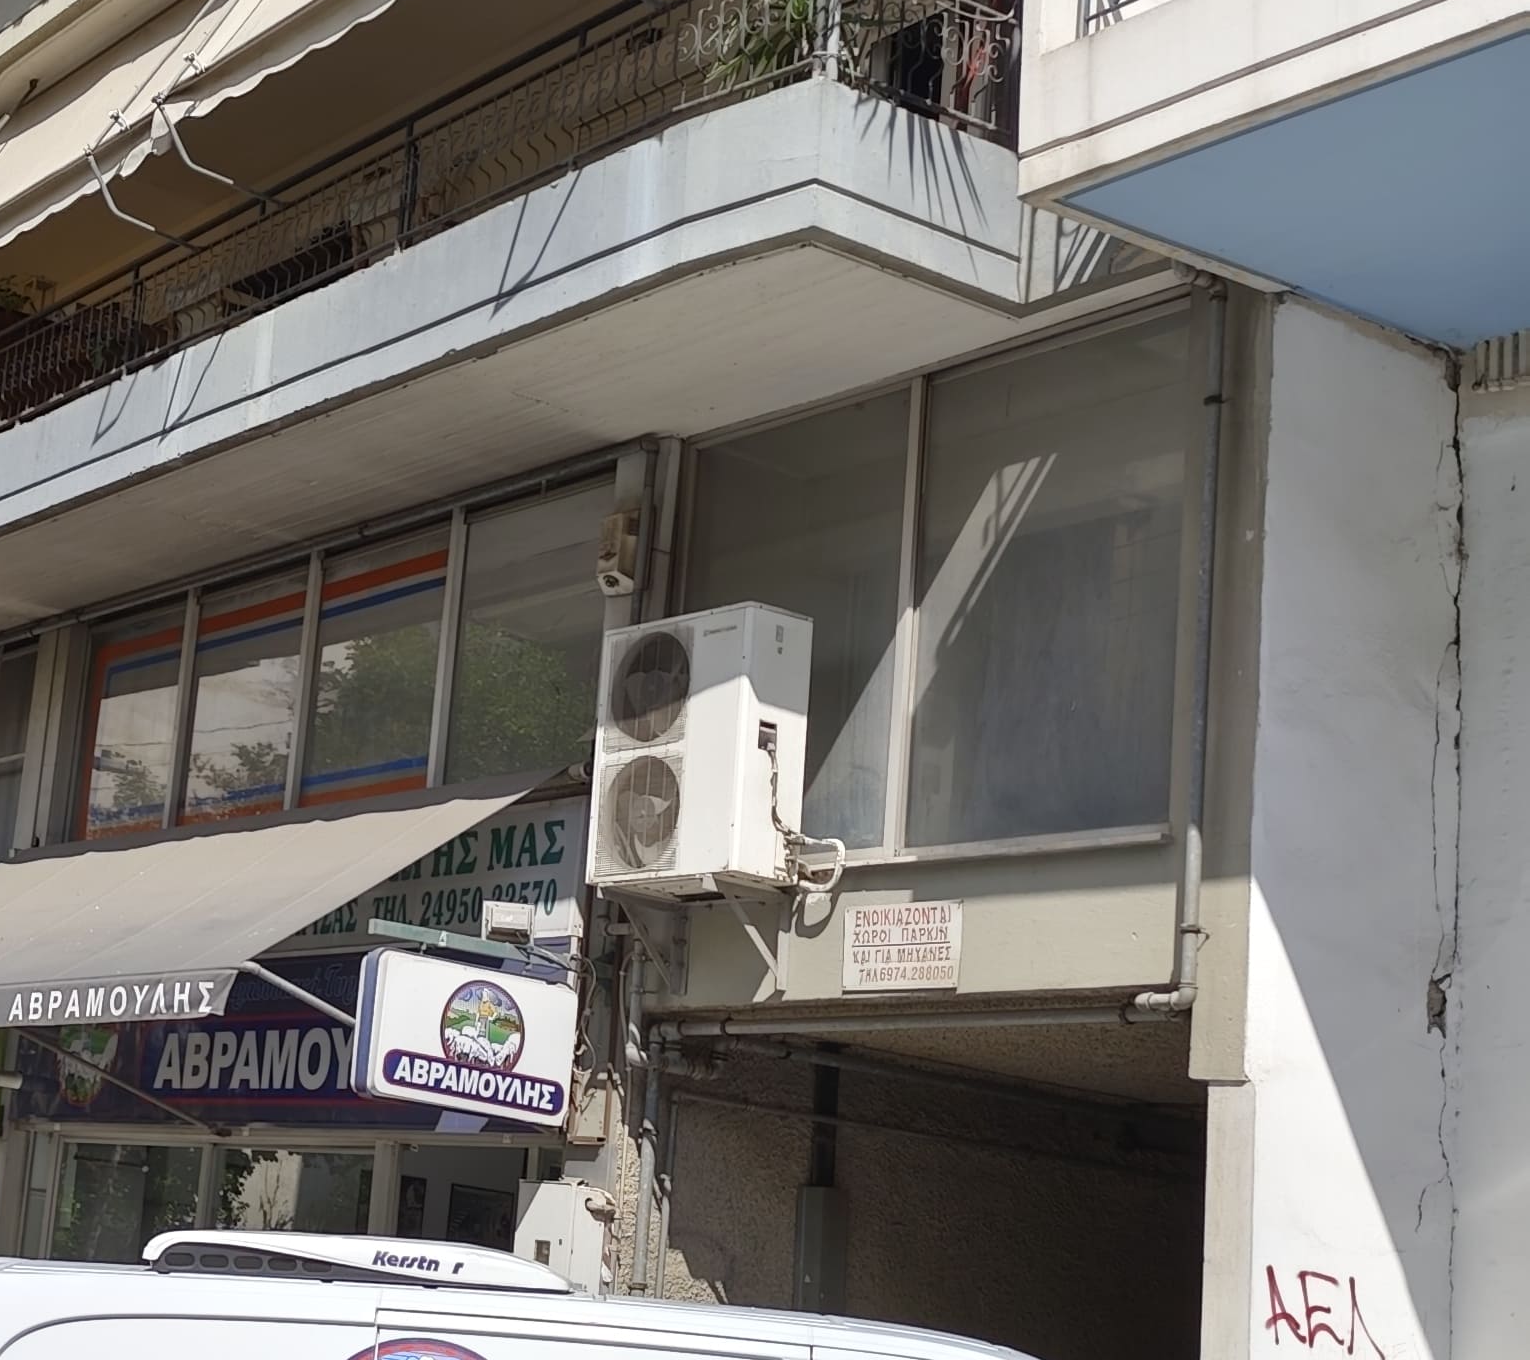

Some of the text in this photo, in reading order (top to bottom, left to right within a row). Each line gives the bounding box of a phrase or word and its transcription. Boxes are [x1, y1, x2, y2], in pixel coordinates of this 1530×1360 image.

[487, 820, 566, 871] ΜΑΣ
[421, 886, 483, 926] 24950
[853, 928, 891, 944] ΧΩΡΟΙ
[853, 946, 951, 965] ΚΑΙ ΓΙΑ ΜΗΧΑΝΕΣ
[8, 981, 214, 1022] ΑΒΡΑΜΟΥΛΗΣ
[393, 1055, 556, 1111] ΑΒΡΑΜΟΥΛΗΣ
[372, 1250, 465, 1275] Kerstnr
